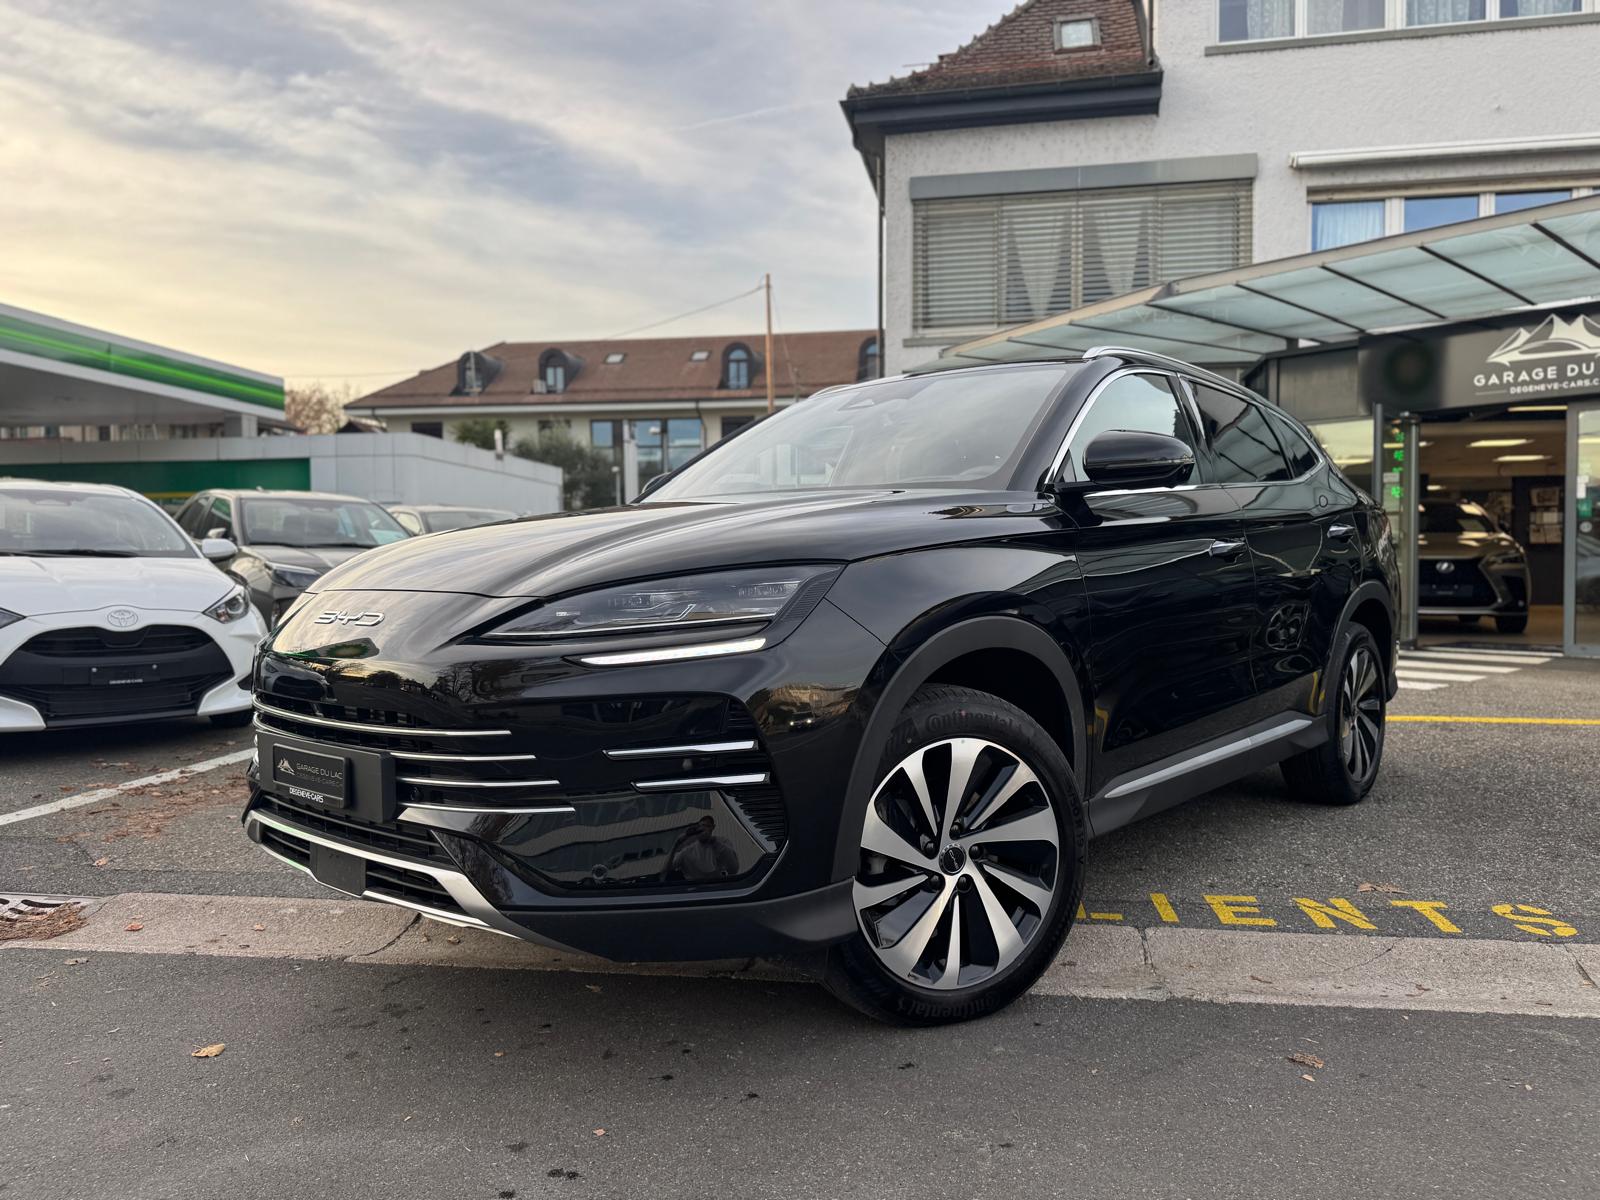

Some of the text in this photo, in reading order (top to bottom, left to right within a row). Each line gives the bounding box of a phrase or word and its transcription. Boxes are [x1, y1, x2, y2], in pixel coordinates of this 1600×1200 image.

[1473, 361, 1595, 387] GARAGE DU
[314, 610, 385, 626] BYD
[296, 762, 320, 775] GARAGE
[320, 768, 330, 777] DU
[330, 770, 343, 780] LAC
[289, 787, 324, 803] DEGENEVE-CARS
